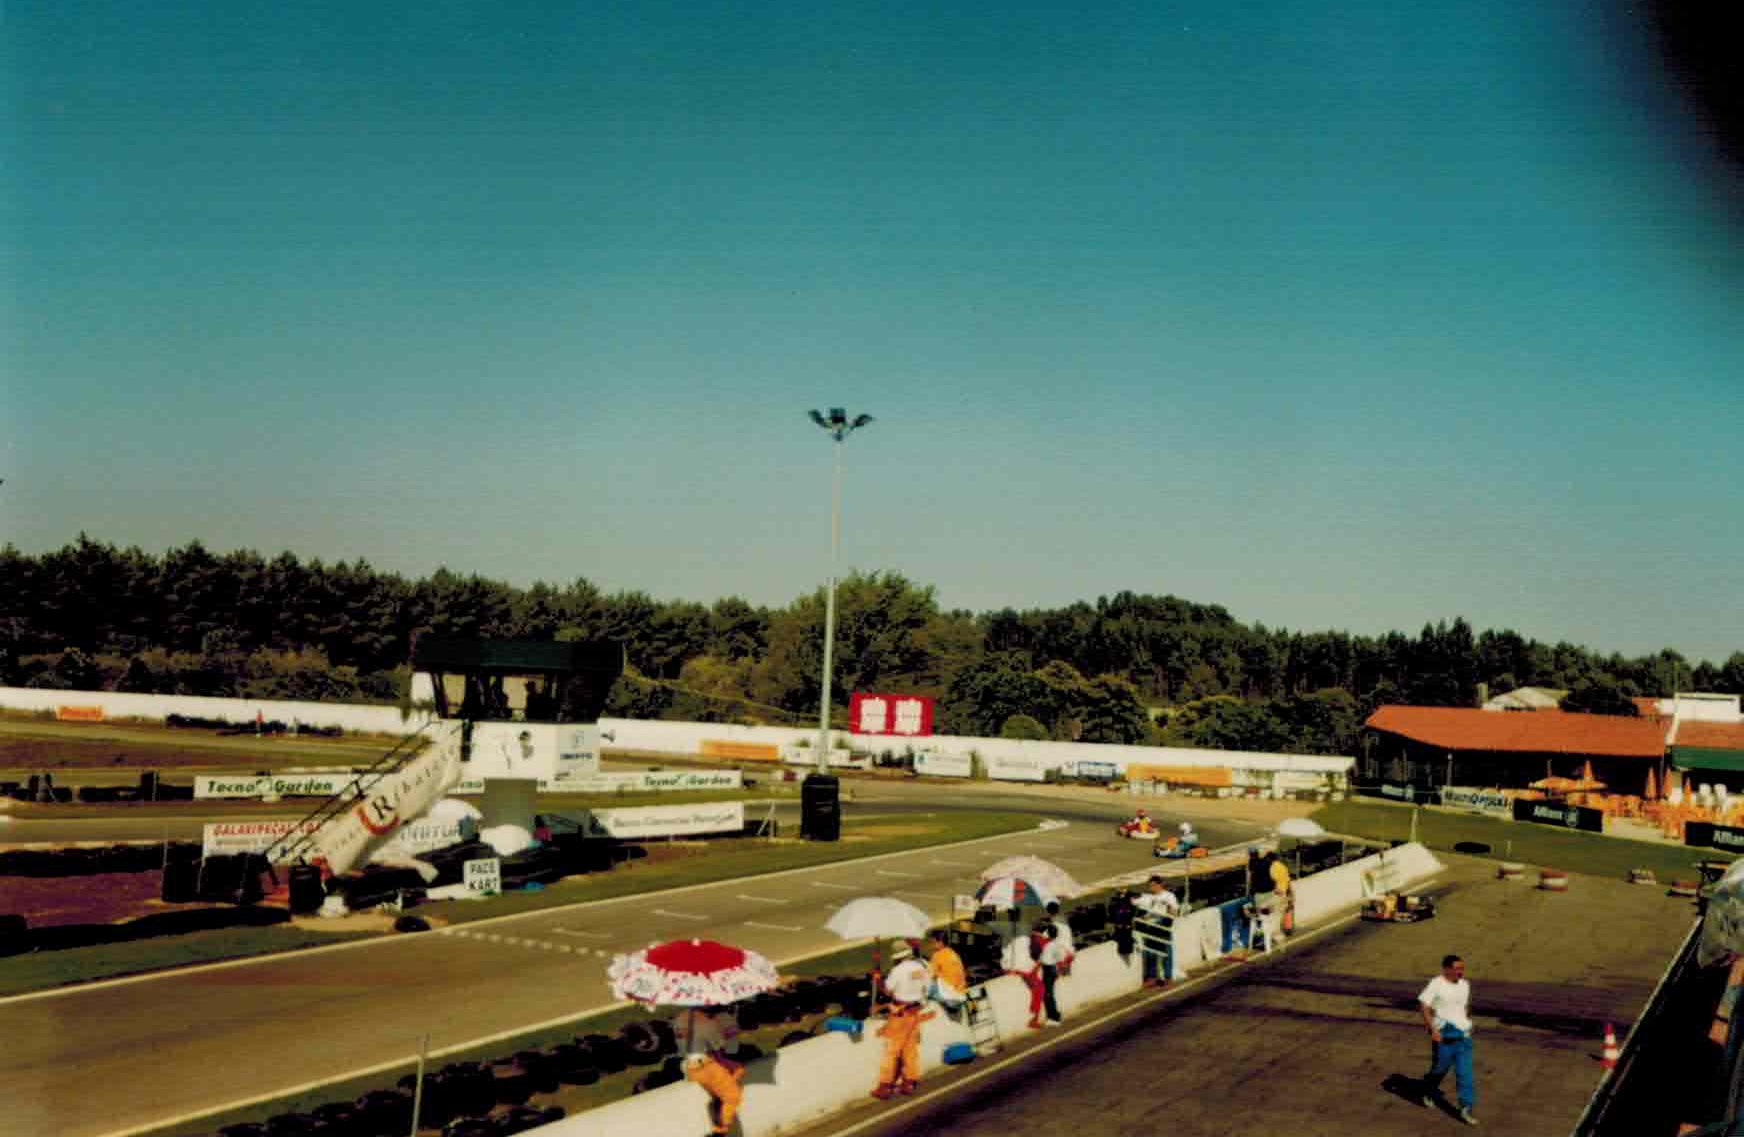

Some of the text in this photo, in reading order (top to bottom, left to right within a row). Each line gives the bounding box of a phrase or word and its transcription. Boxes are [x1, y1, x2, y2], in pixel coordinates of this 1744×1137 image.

[208, 779, 333, 794] Tecno Garden
[469, 877, 498, 891] KART
